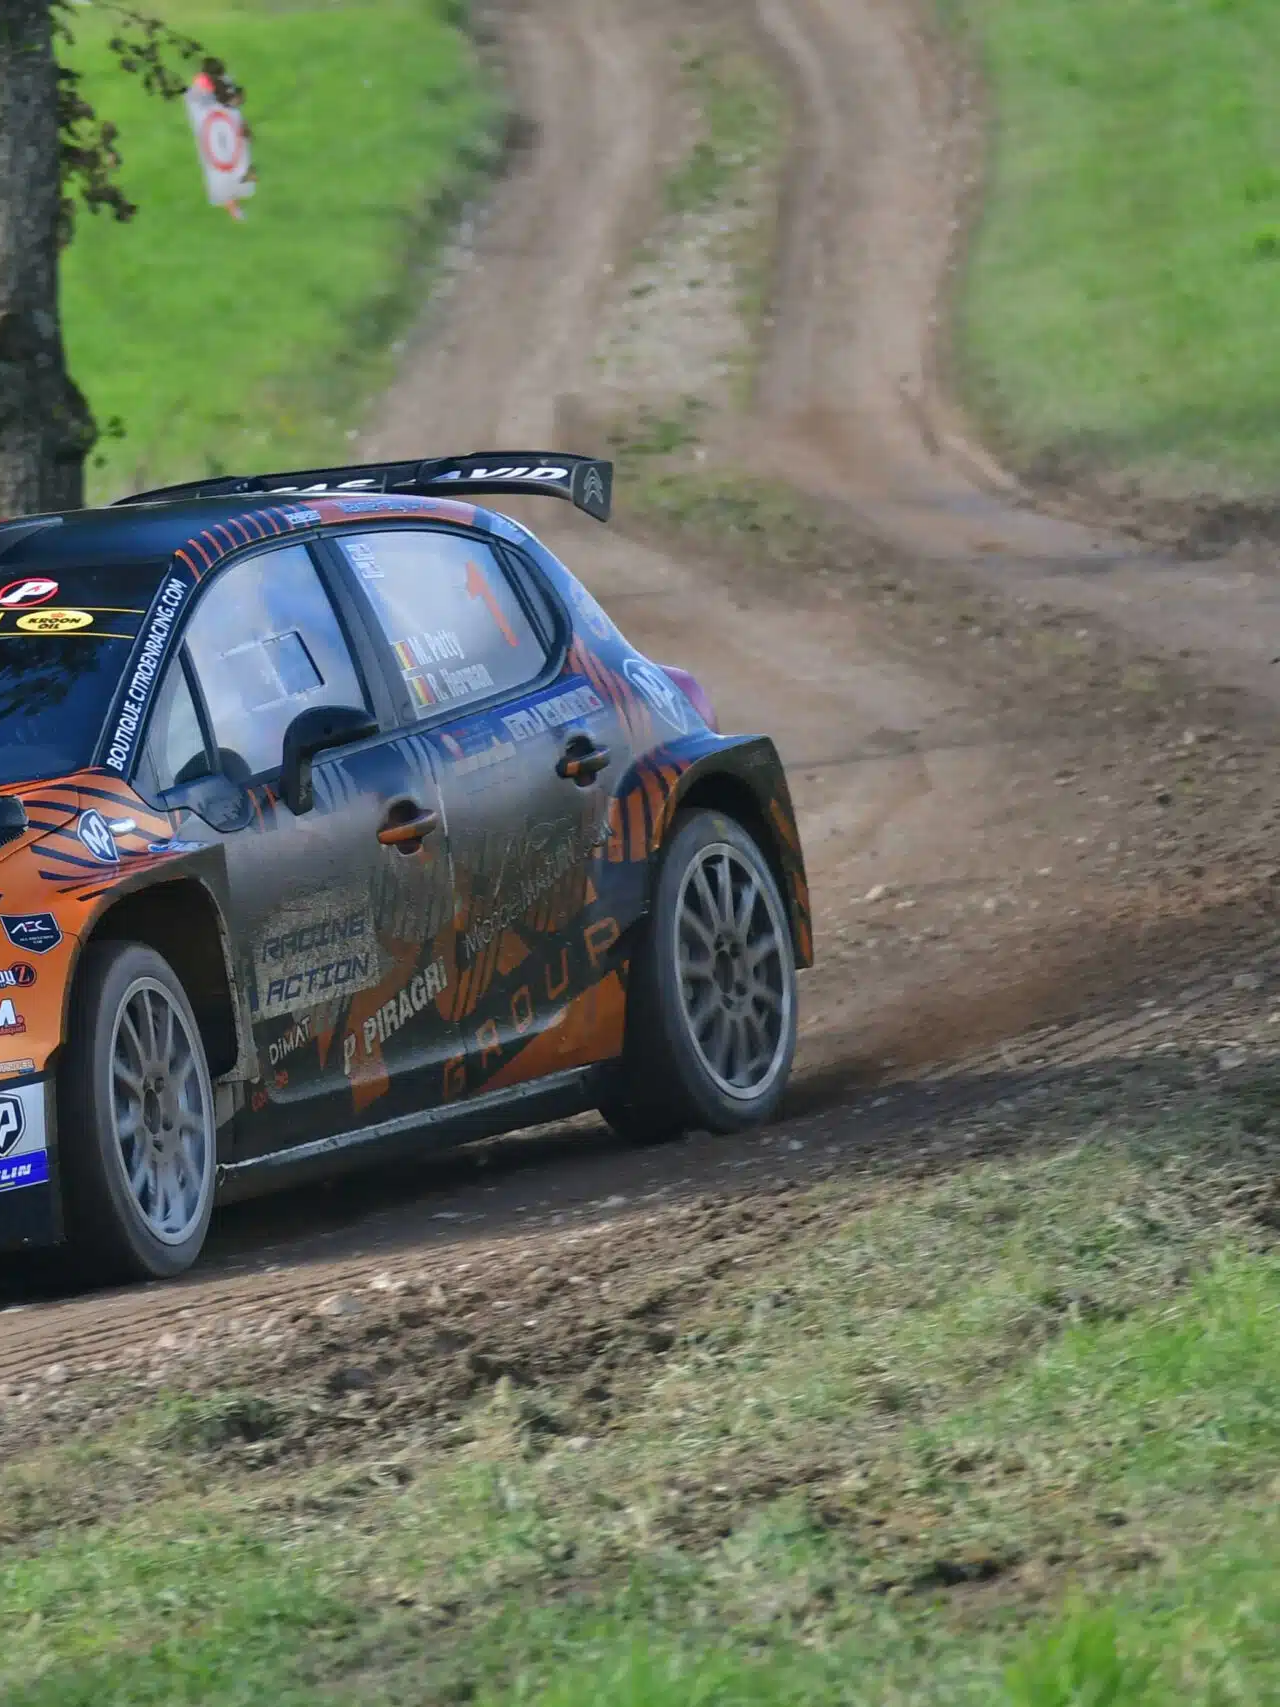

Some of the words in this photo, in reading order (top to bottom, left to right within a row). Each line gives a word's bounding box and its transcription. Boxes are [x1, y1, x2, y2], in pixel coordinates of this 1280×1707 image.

[28, 616, 81, 625] KROON
[37, 622, 60, 630] OIL
[106, 578, 187, 771] BOUTIQUE.CITROENRACING.COM
[263, 915, 366, 964] RACING
[266, 952, 370, 1006] ACTION
[363, 956, 448, 1055] PIRAGRI
